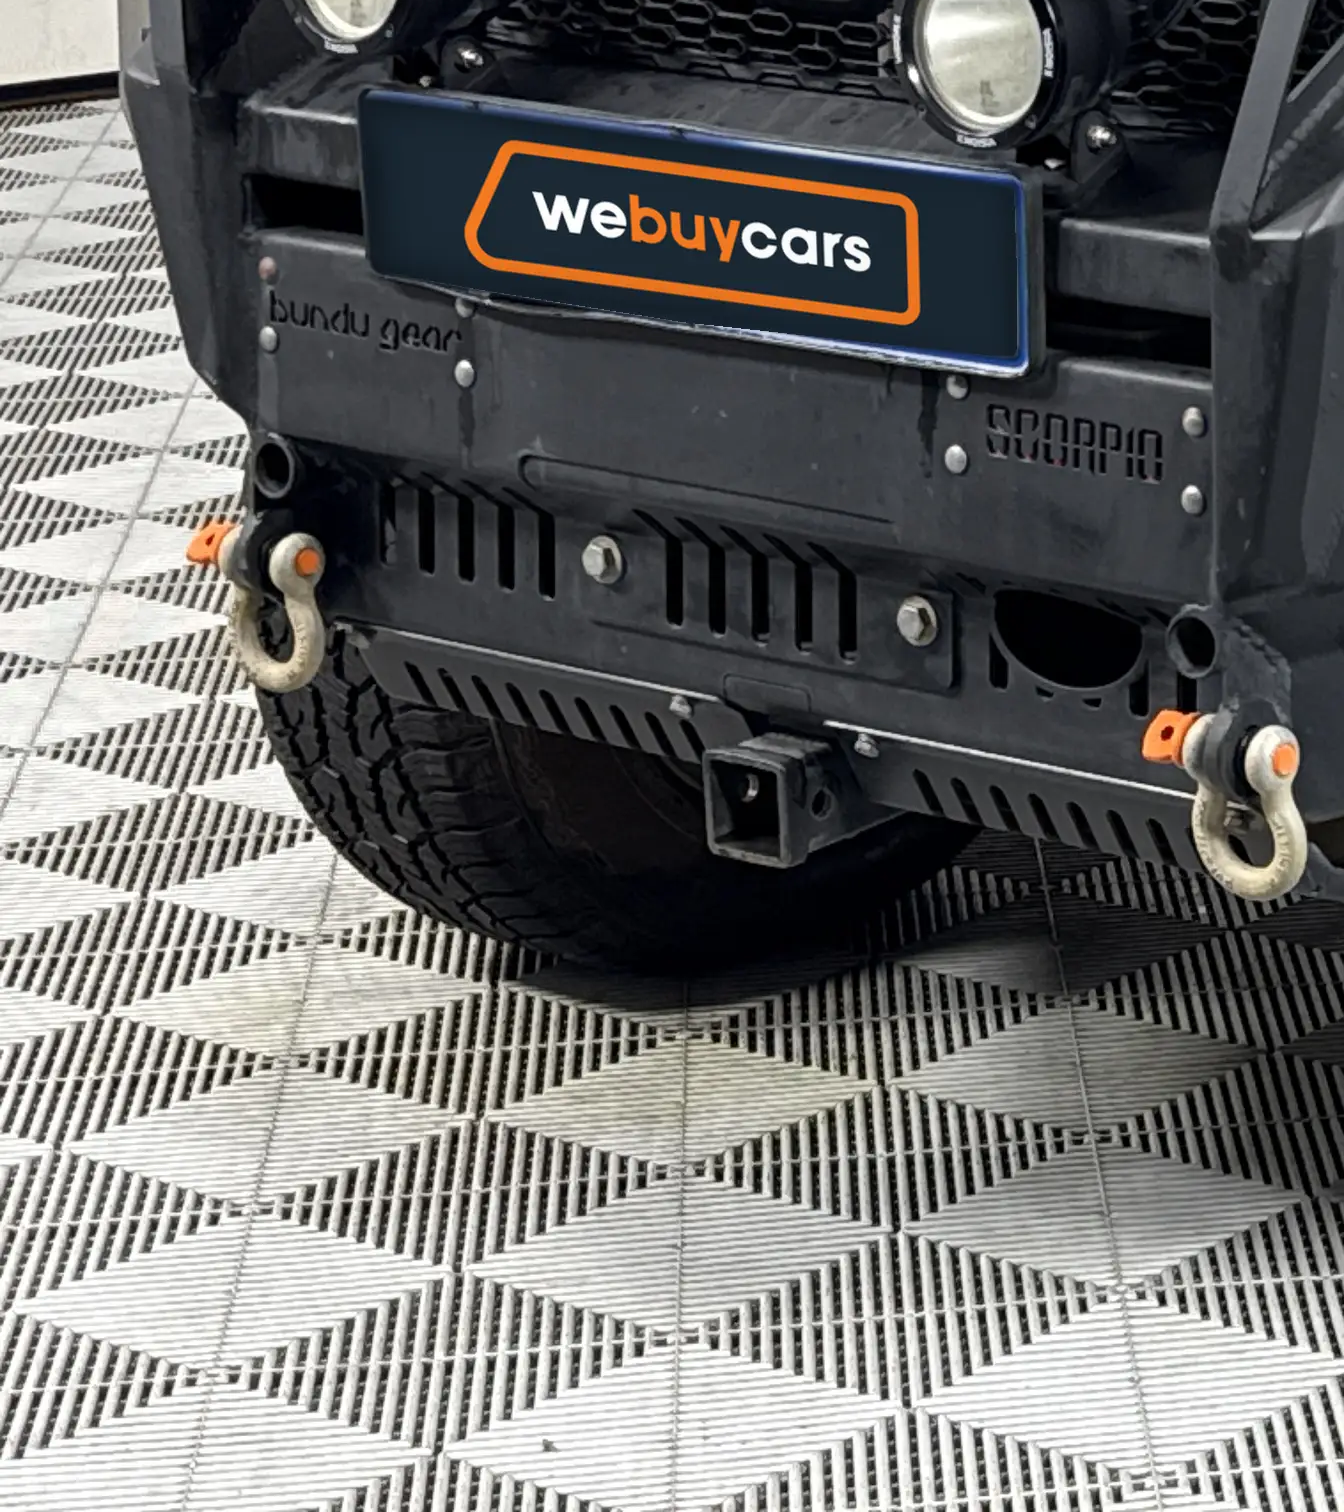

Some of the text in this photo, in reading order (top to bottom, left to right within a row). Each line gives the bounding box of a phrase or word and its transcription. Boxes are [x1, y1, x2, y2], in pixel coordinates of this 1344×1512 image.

[269, 289, 463, 352] bundu gear
[985, 403, 1164, 484] SCORPIO
